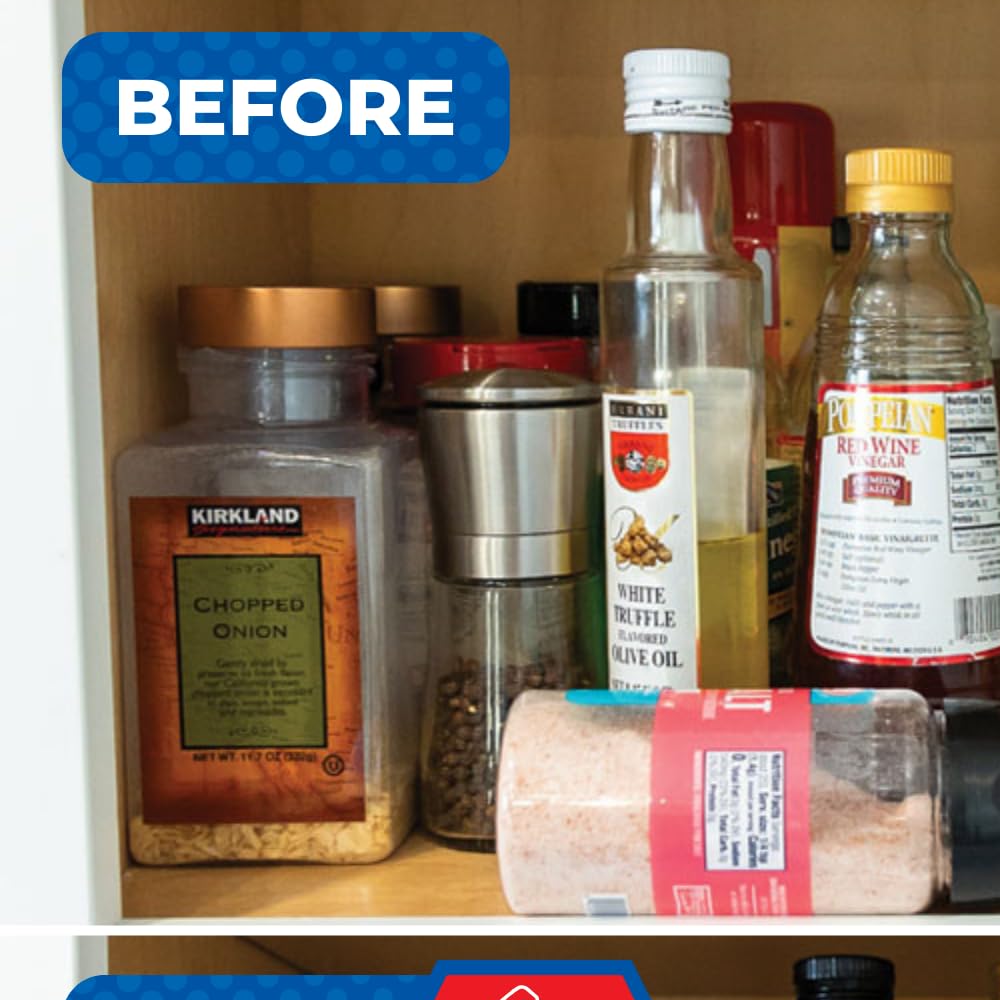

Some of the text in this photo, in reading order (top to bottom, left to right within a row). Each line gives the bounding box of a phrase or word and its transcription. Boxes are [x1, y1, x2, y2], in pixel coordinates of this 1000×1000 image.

[826, 397, 933, 434] POPEIAN
[837, 436, 921, 455] RED WINE
[848, 456, 906, 468] VNEGAR
[191, 507, 300, 525] KIRKLAND
[617, 583, 666, 604] WHITE
[193, 597, 305, 614] CHOPPED
[613, 605, 677, 628] TRUFFLE
[213, 624, 288, 639] ONION
[611, 645, 684, 668] OLIVE OIL
